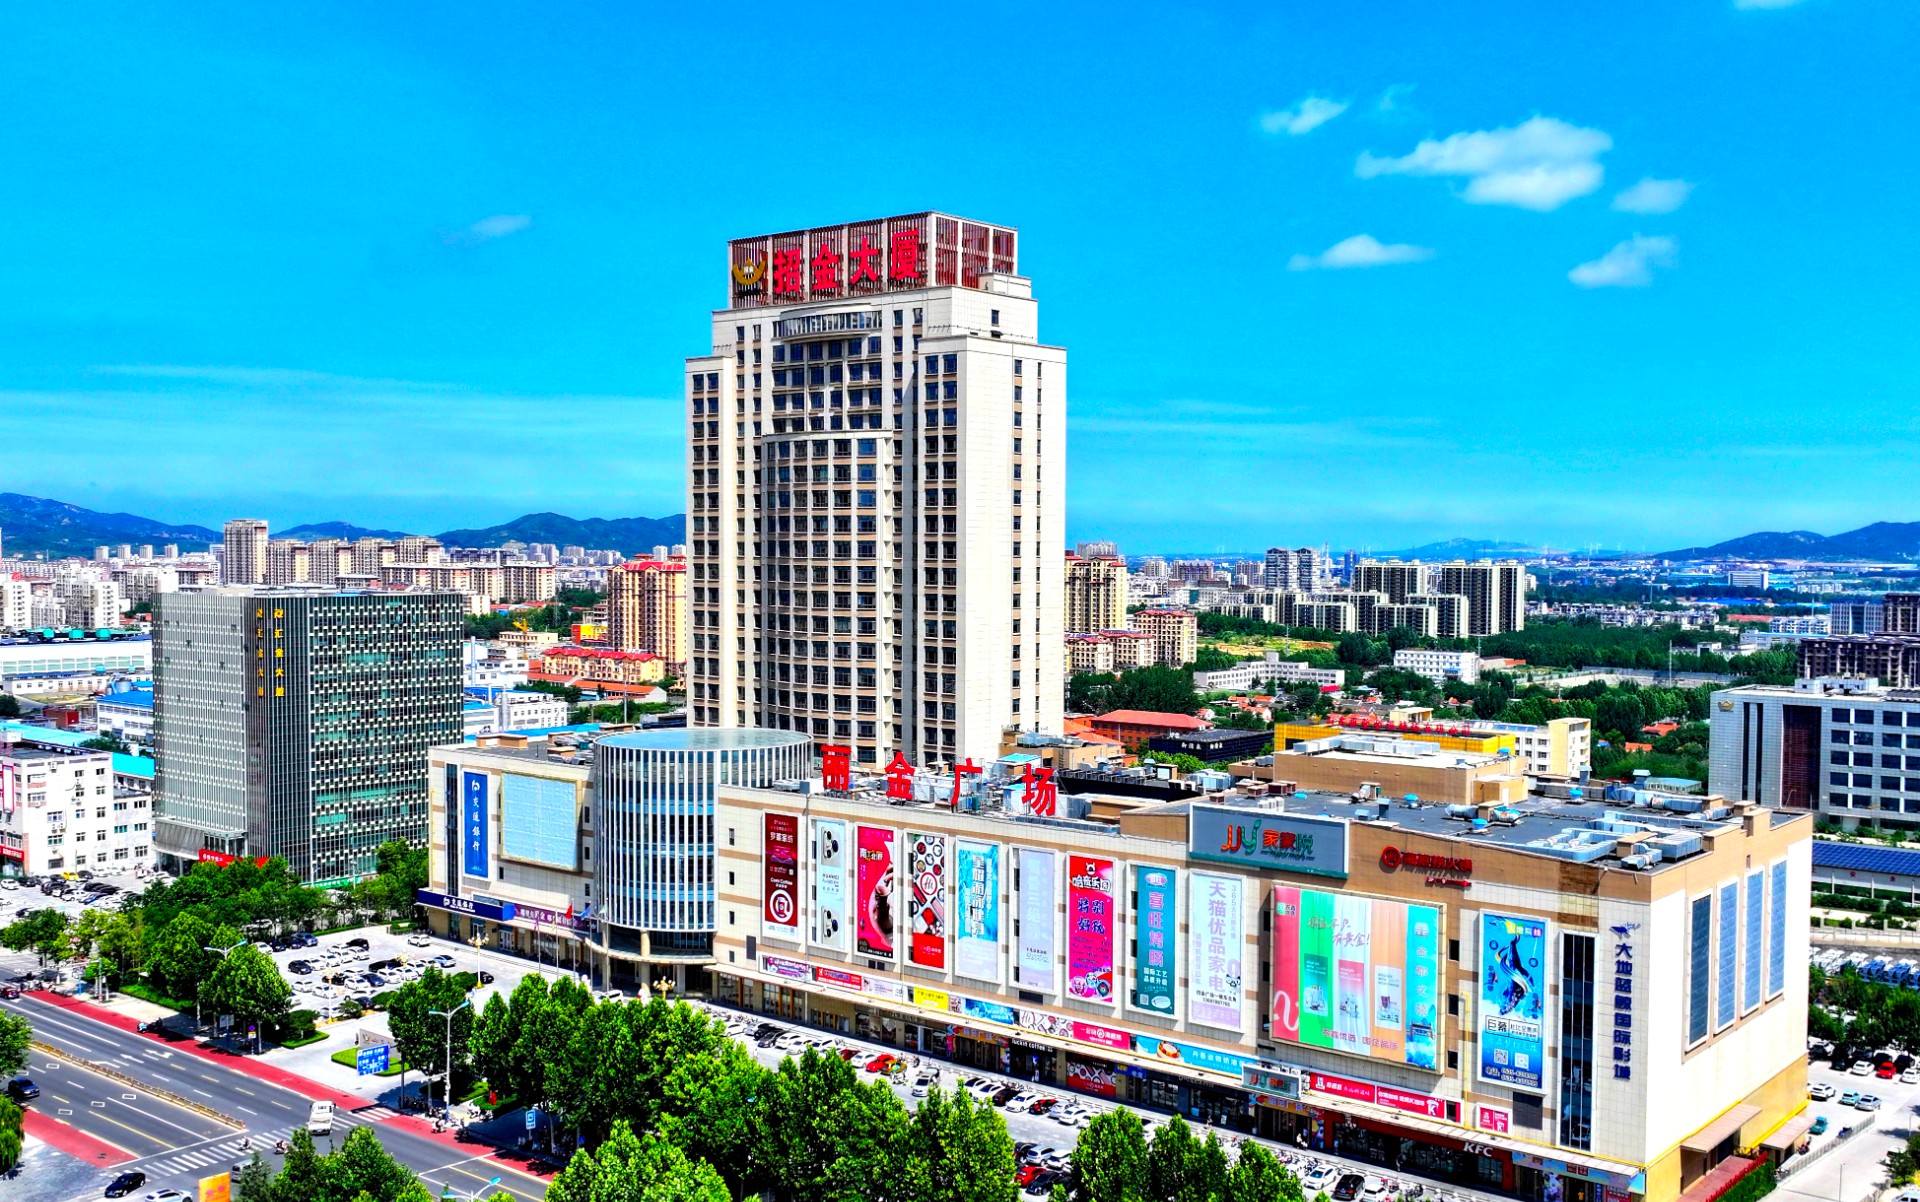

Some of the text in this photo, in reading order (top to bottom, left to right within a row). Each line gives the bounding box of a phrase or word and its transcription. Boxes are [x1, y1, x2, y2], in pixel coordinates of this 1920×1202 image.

[774, 230, 919, 294] 招金大厦
[1221, 819, 1262, 855] JJY
[1263, 829, 1314, 855] 家家悦
[1078, 897, 1105, 916] 特别
[1148, 891, 1164, 968] 喜旺烤肠
[1208, 880, 1227, 993] 天猫优品家电
[1414, 922, 1429, 1016] 金都文旅
[1487, 1019, 1508, 1033] 巨幕
[1028, 1043, 1046, 1052] coffee
[1192, 1051, 1253, 1068] 丹香动物奶油
[1463, 1141, 1493, 1158] KFC
